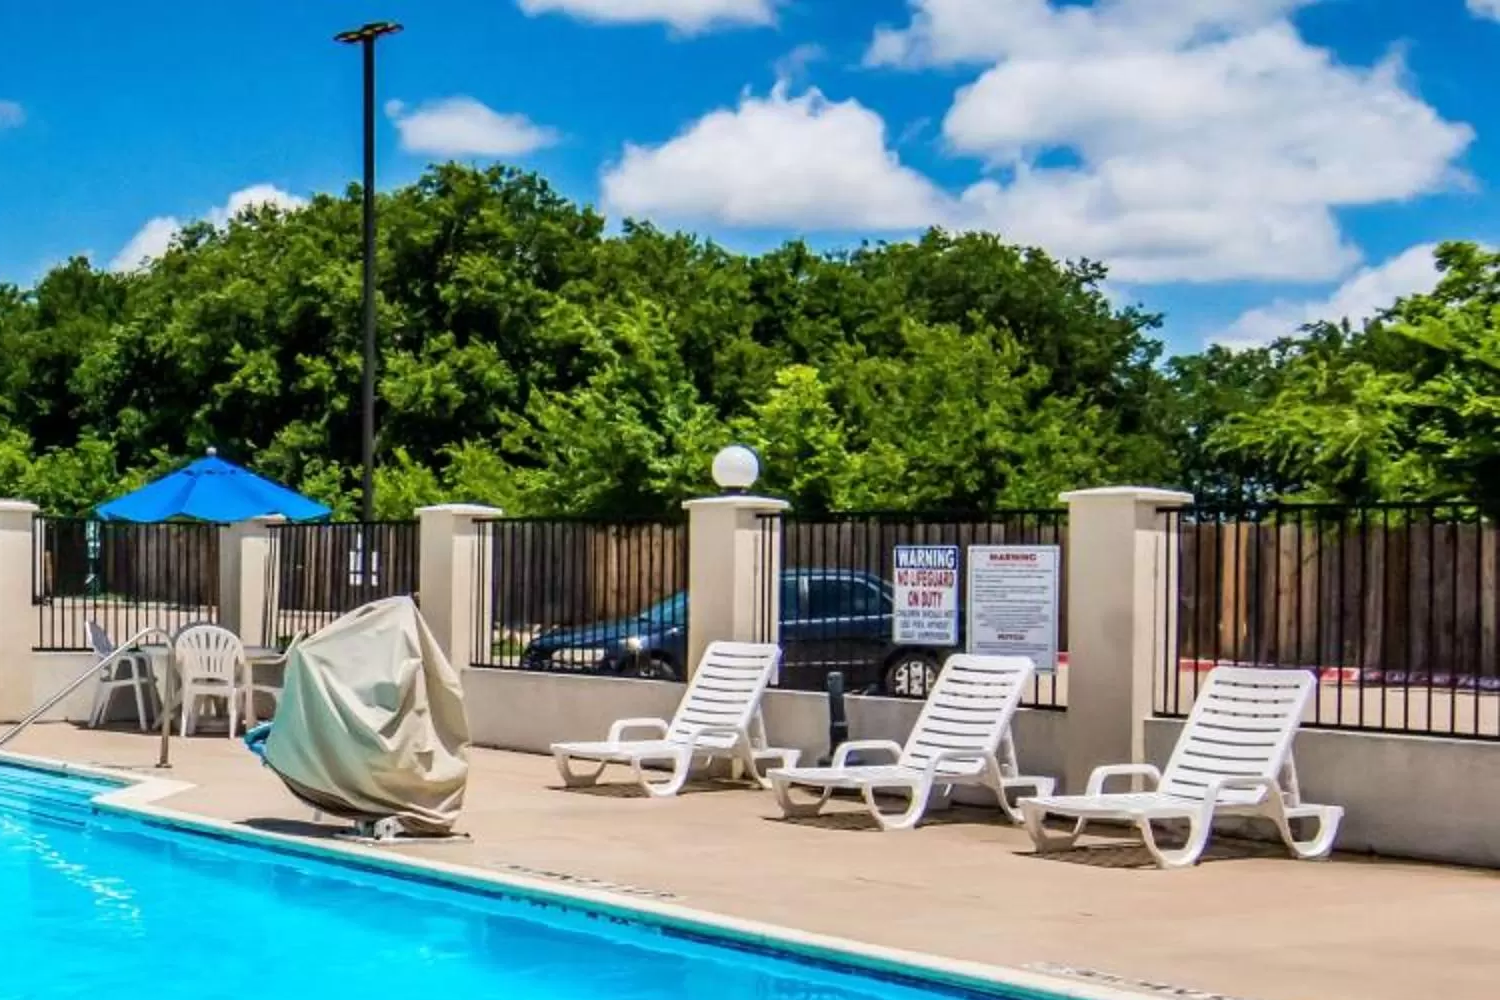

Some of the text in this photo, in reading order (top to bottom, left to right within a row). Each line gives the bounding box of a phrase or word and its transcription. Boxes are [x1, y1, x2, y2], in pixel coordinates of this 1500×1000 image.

[898, 549, 954, 568] WARNING
[898, 571, 954, 588] NO LIFEGUARD
[908, 591, 943, 608] ON DUTY
